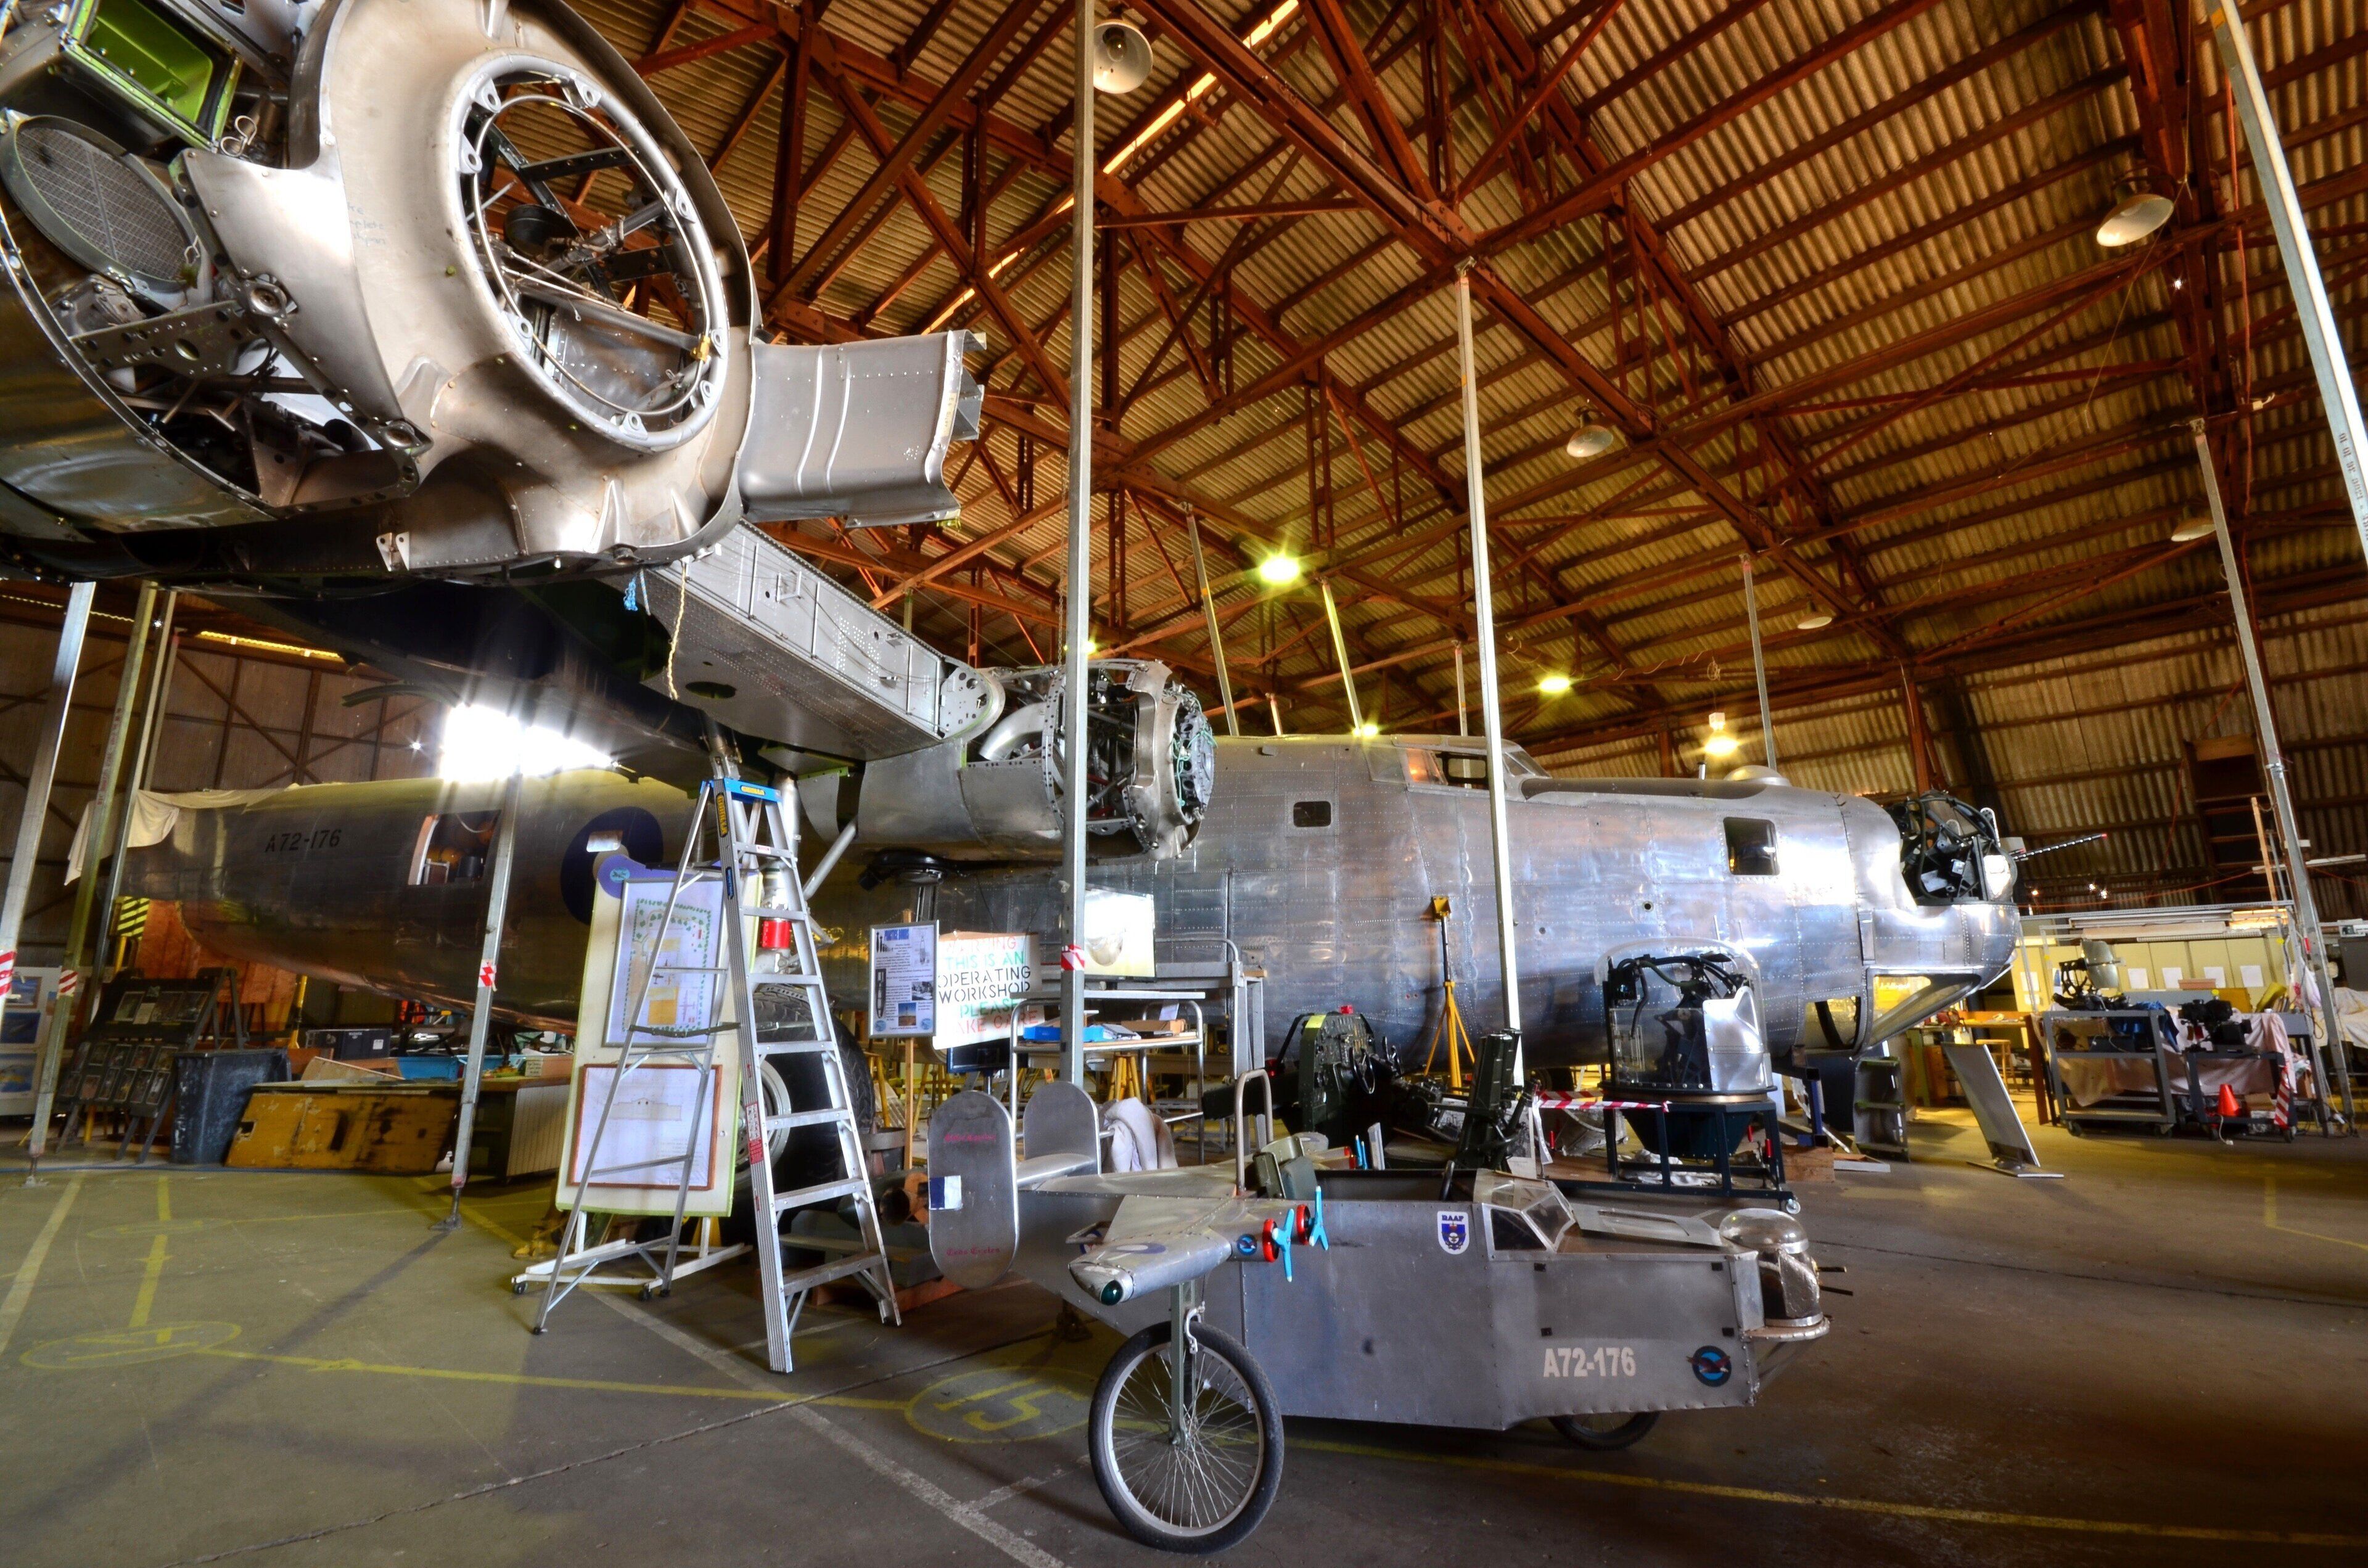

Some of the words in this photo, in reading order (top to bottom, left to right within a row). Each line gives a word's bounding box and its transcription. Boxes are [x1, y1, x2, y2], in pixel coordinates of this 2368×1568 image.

[265, 829, 342, 853] A72-176
[945, 954, 978, 970] THIS
[985, 952, 995, 968] IS
[1003, 951, 1025, 966] AN
[938, 966, 1031, 988] OPERATING
[939, 981, 1030, 1004] WORKSHOP
[1543, 1347, 1637, 1378] A72-176
